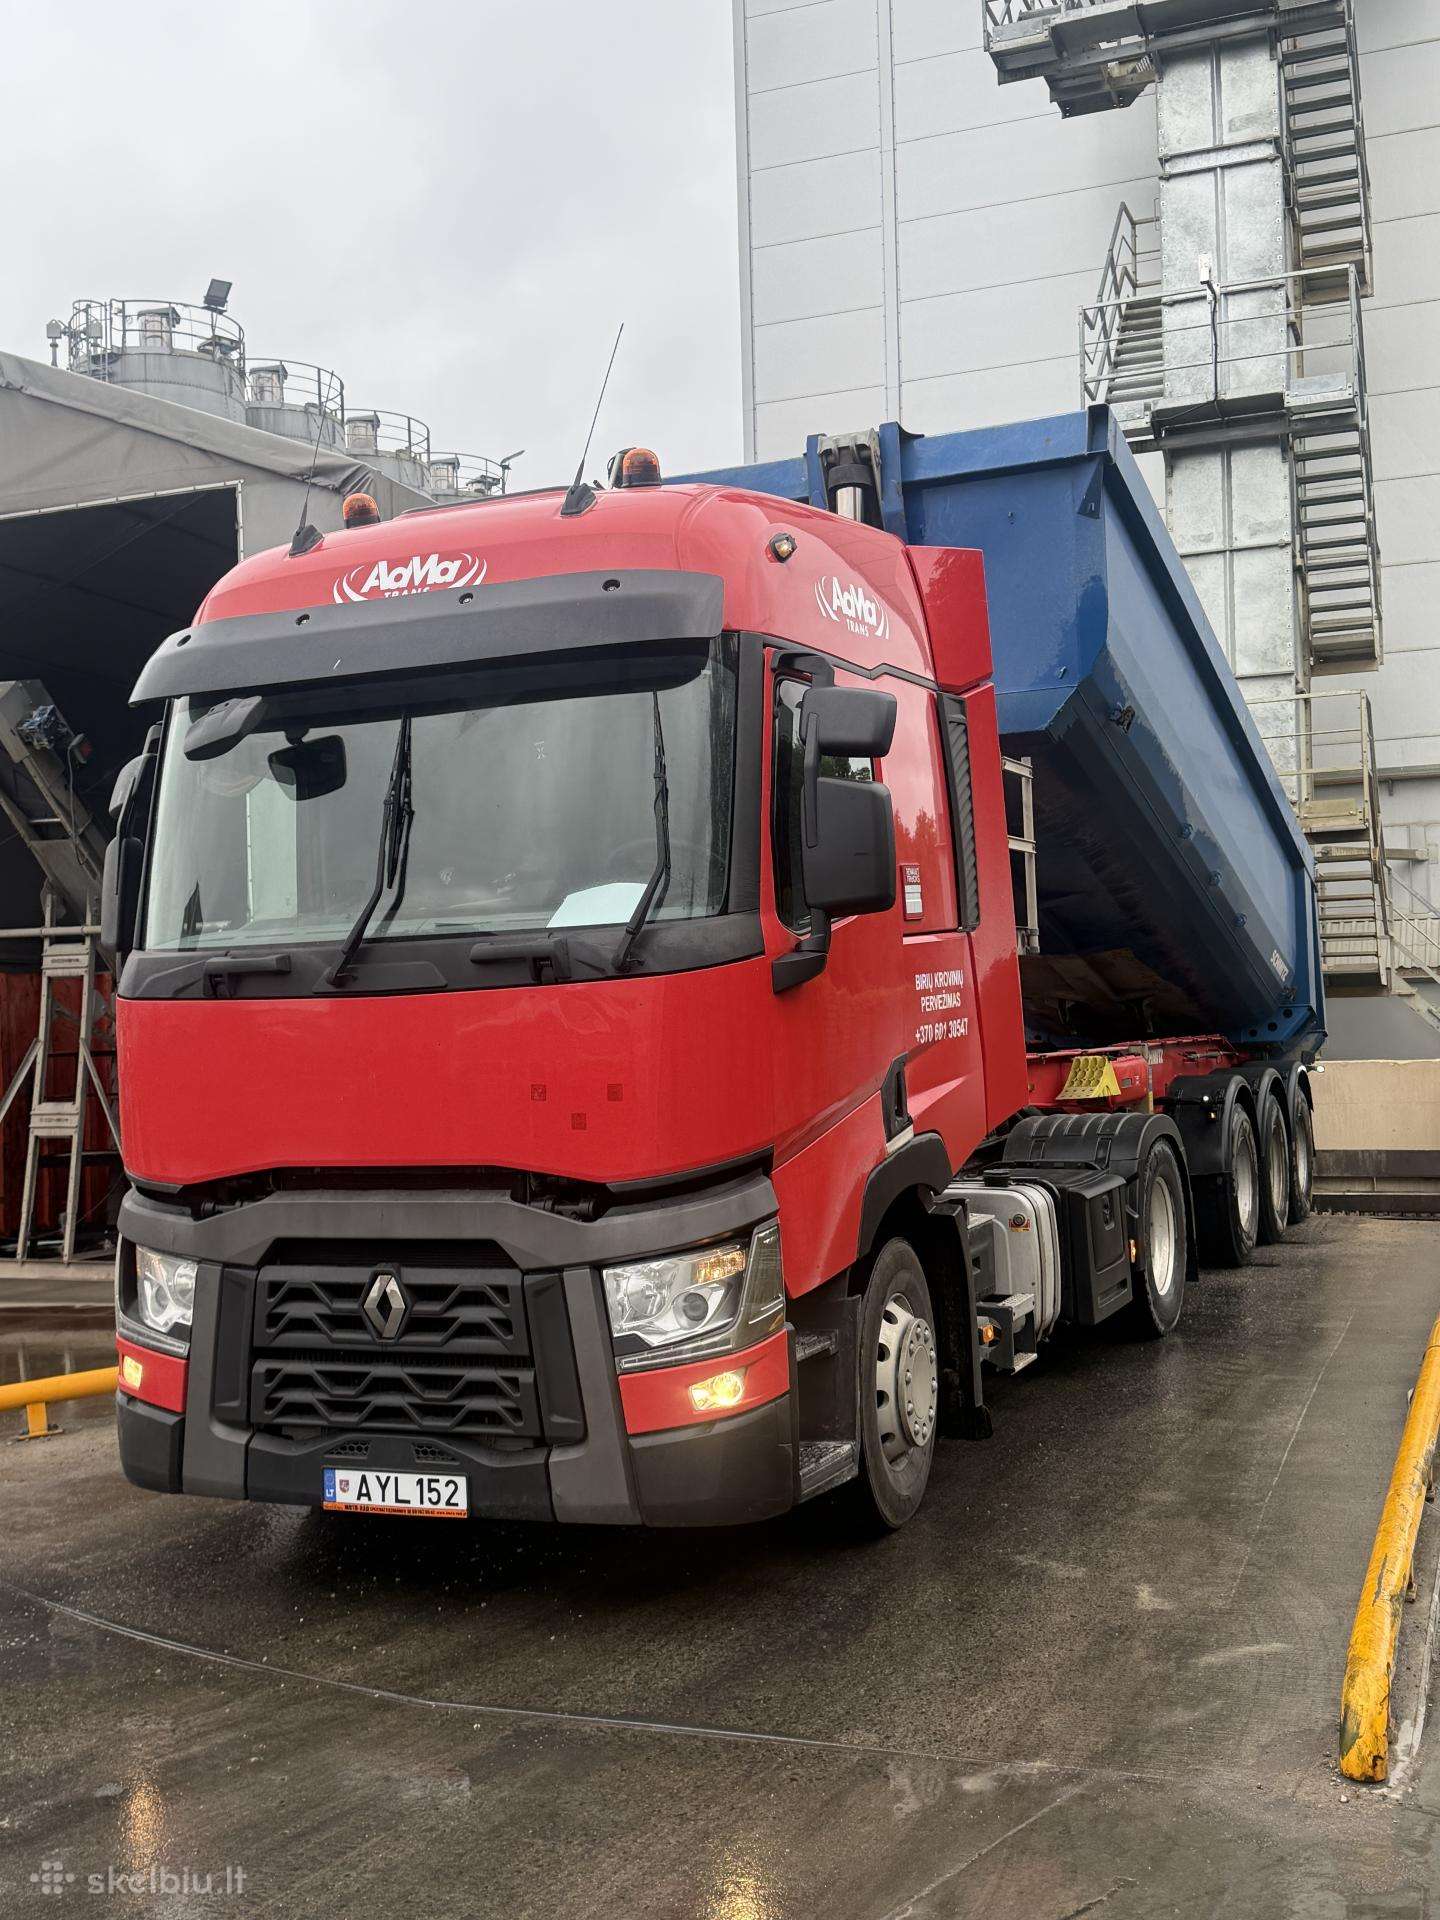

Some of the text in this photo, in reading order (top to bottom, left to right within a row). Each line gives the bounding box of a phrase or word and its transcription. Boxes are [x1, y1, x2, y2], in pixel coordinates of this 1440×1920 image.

[846, 619, 869, 637] TRANS
[920, 990, 961, 1012] PERVEŽIMAS
[915, 1024, 934, 1044] +370
[326, 1488, 335, 1498] LT
[356, 1474, 459, 1507] AYL 152
